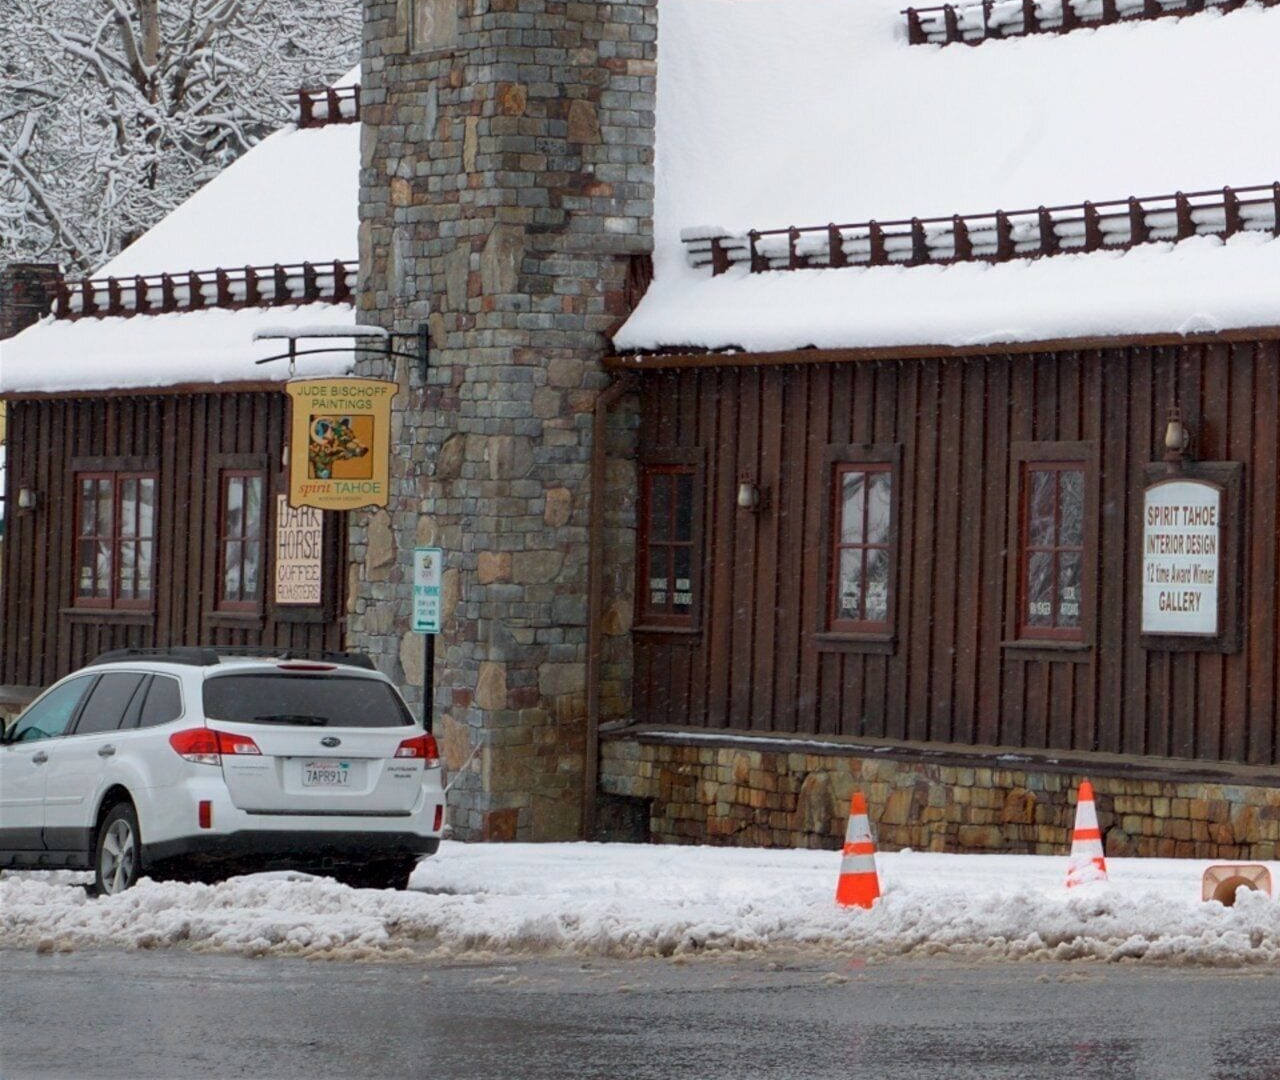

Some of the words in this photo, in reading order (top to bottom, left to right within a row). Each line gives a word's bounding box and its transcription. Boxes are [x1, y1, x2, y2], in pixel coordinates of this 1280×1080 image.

[297, 386, 328, 397] JUDE
[330, 386, 389, 397] BISCHOFF
[311, 399, 372, 409] PAINTINGS
[298, 481, 332, 498] spirit
[334, 481, 381, 494] TAHOE
[279, 499, 320, 528] DARK
[1147, 506, 1179, 526] SPIRIT
[1183, 506, 1215, 526] TAHOE
[279, 530, 320, 559] HORSE
[1147, 534, 1184, 554] INTERIOR
[1186, 534, 1216, 555] DESIGN
[278, 565, 320, 581] COFFEE
[1171, 563, 1191, 583] Award
[1159, 591, 1201, 612] GALLERY
[306, 770, 348, 784] 7APR917
